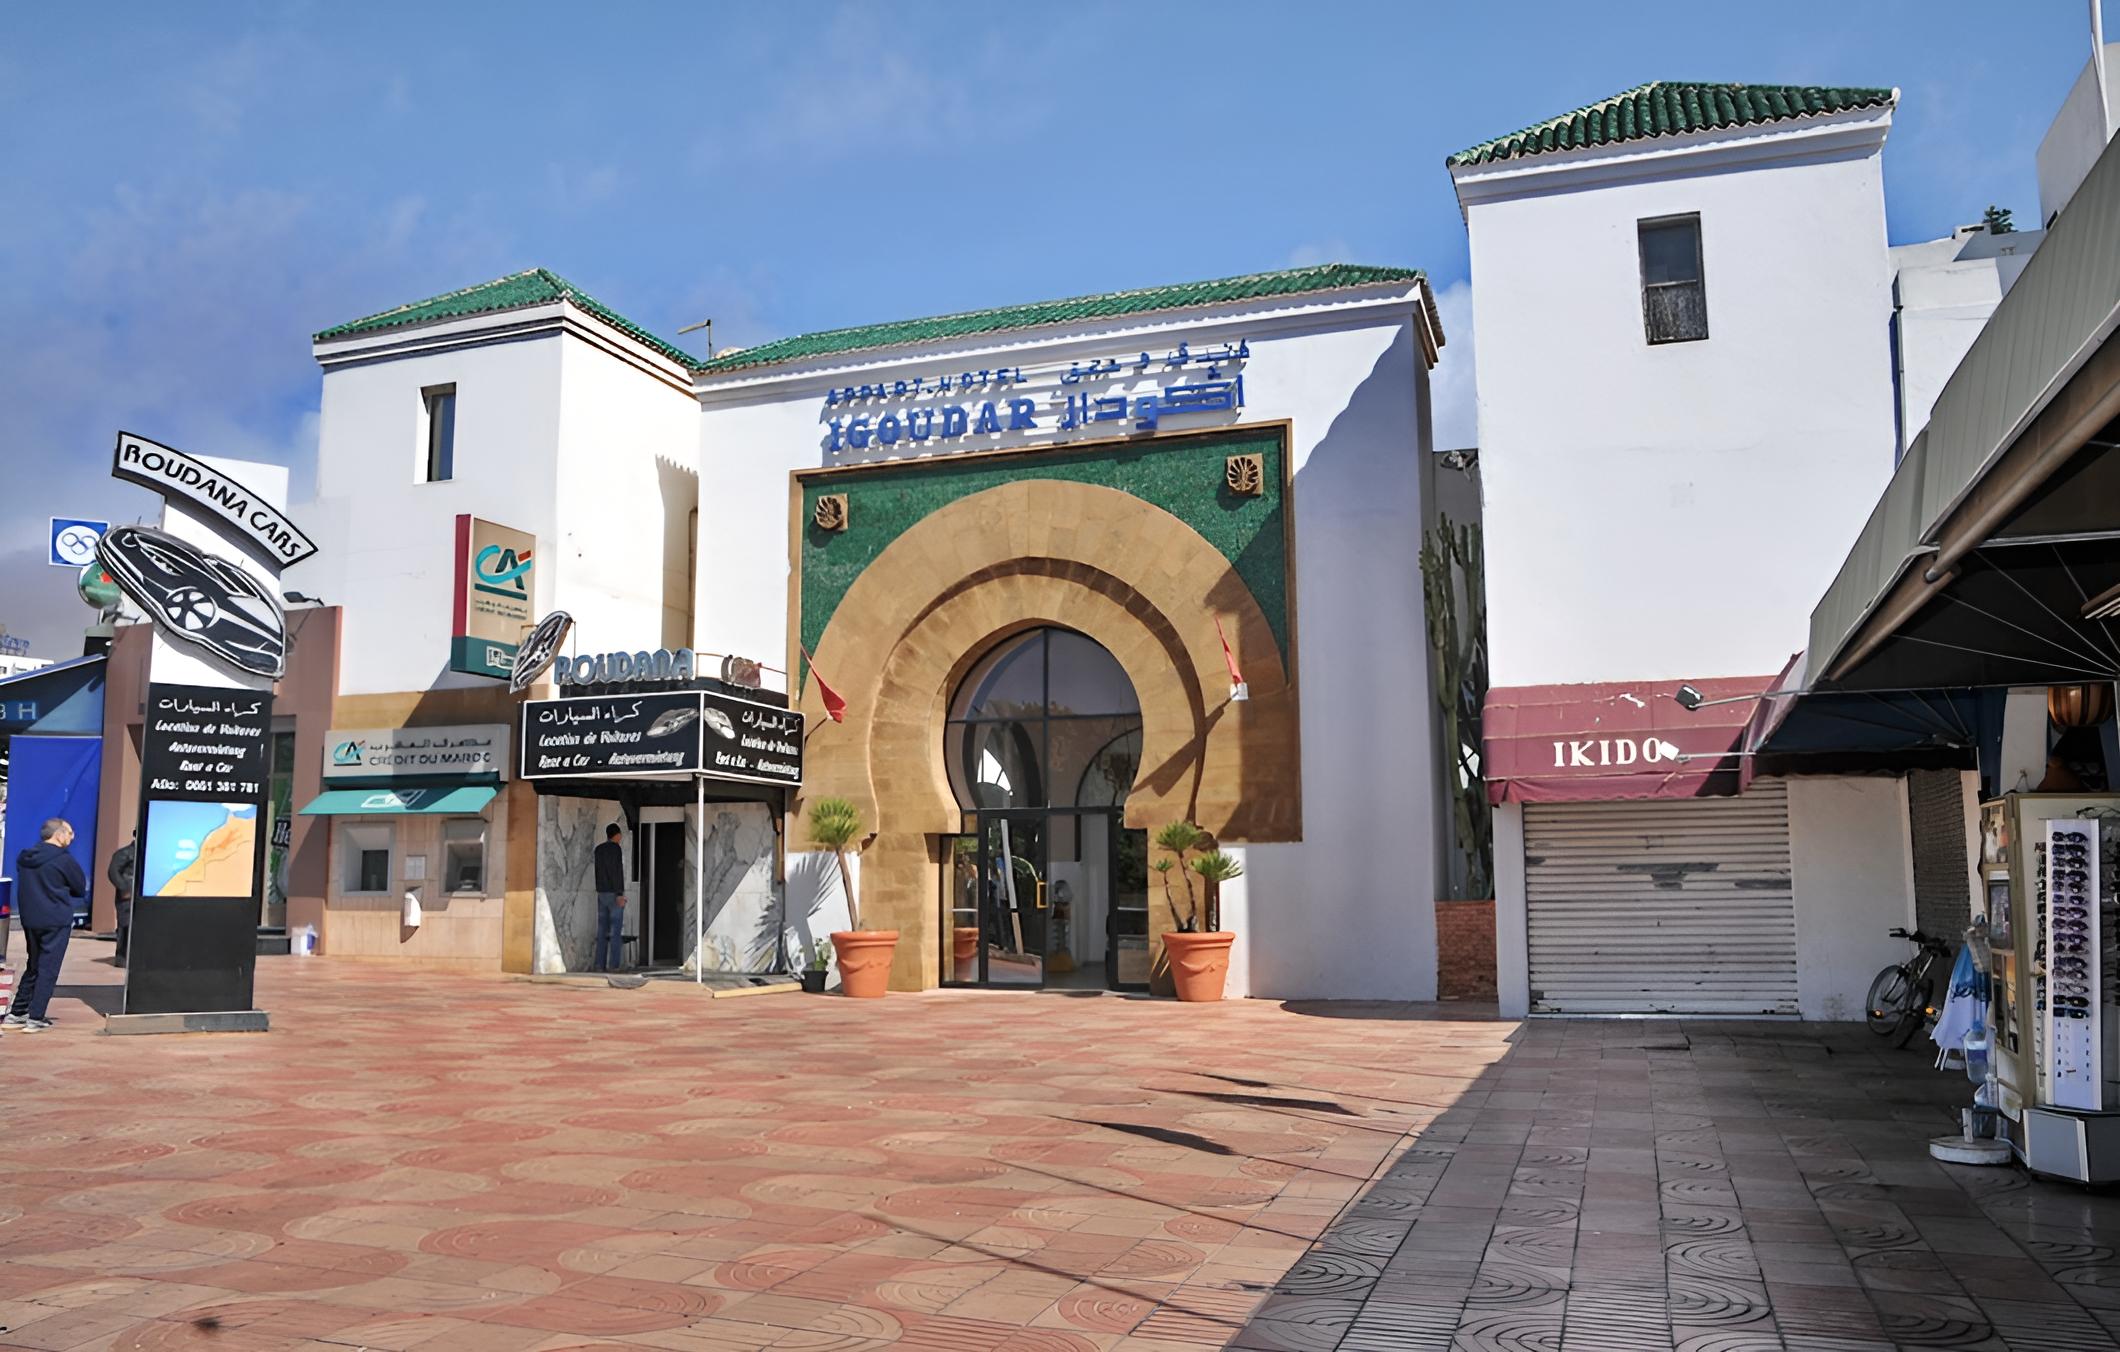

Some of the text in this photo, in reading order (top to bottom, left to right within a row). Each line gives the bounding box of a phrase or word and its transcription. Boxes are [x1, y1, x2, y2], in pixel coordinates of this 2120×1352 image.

[829, 398, 1038, 452] IGOUDAR
[124, 444, 301, 557] ROUDANA CARS
[554, 649, 694, 685] ROUDANA
[539, 700, 643, 725] كراء السيارات
[1553, 737, 1662, 767] IKIDO
